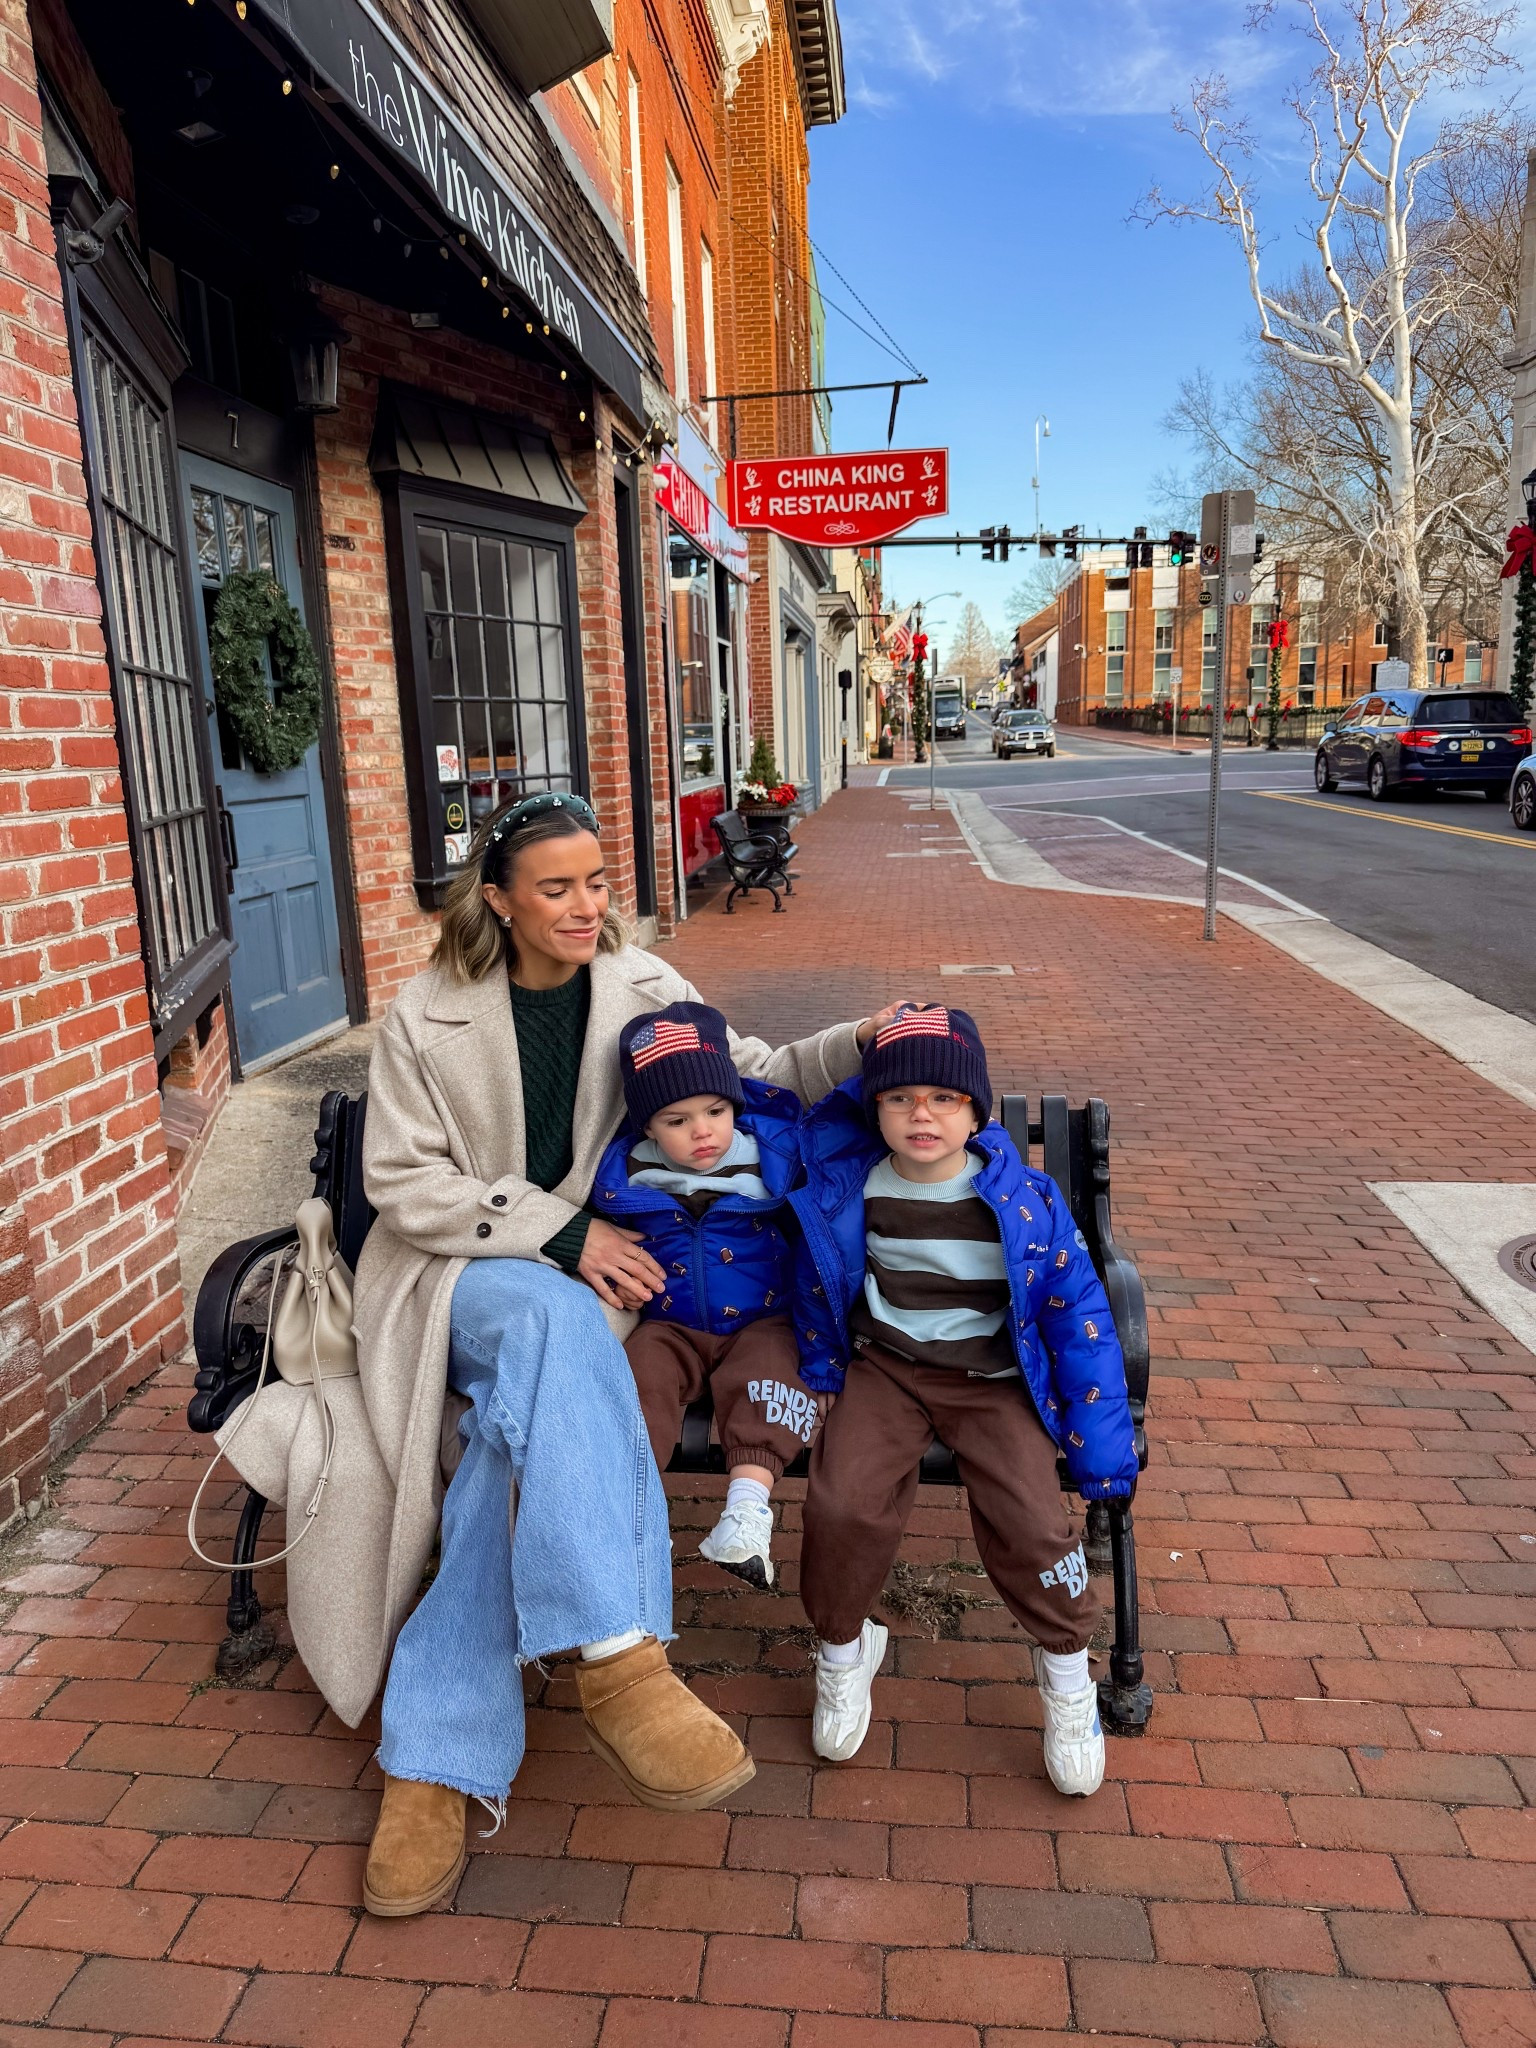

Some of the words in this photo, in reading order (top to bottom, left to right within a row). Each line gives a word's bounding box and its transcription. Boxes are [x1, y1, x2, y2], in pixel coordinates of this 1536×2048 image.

[348, 39, 404, 147] the
[393, 61, 493, 252] Wine
[492, 189, 583, 353] Kitchen
[227, 410, 239, 449] 7
[777, 466, 846, 489] CHINA
[851, 462, 905, 486] KING
[670, 464, 707, 537] CHINA
[768, 489, 915, 517] RESTAURANT
[747, 1379, 819, 1426] REINDE
[766, 1400, 813, 1443] DAYS
